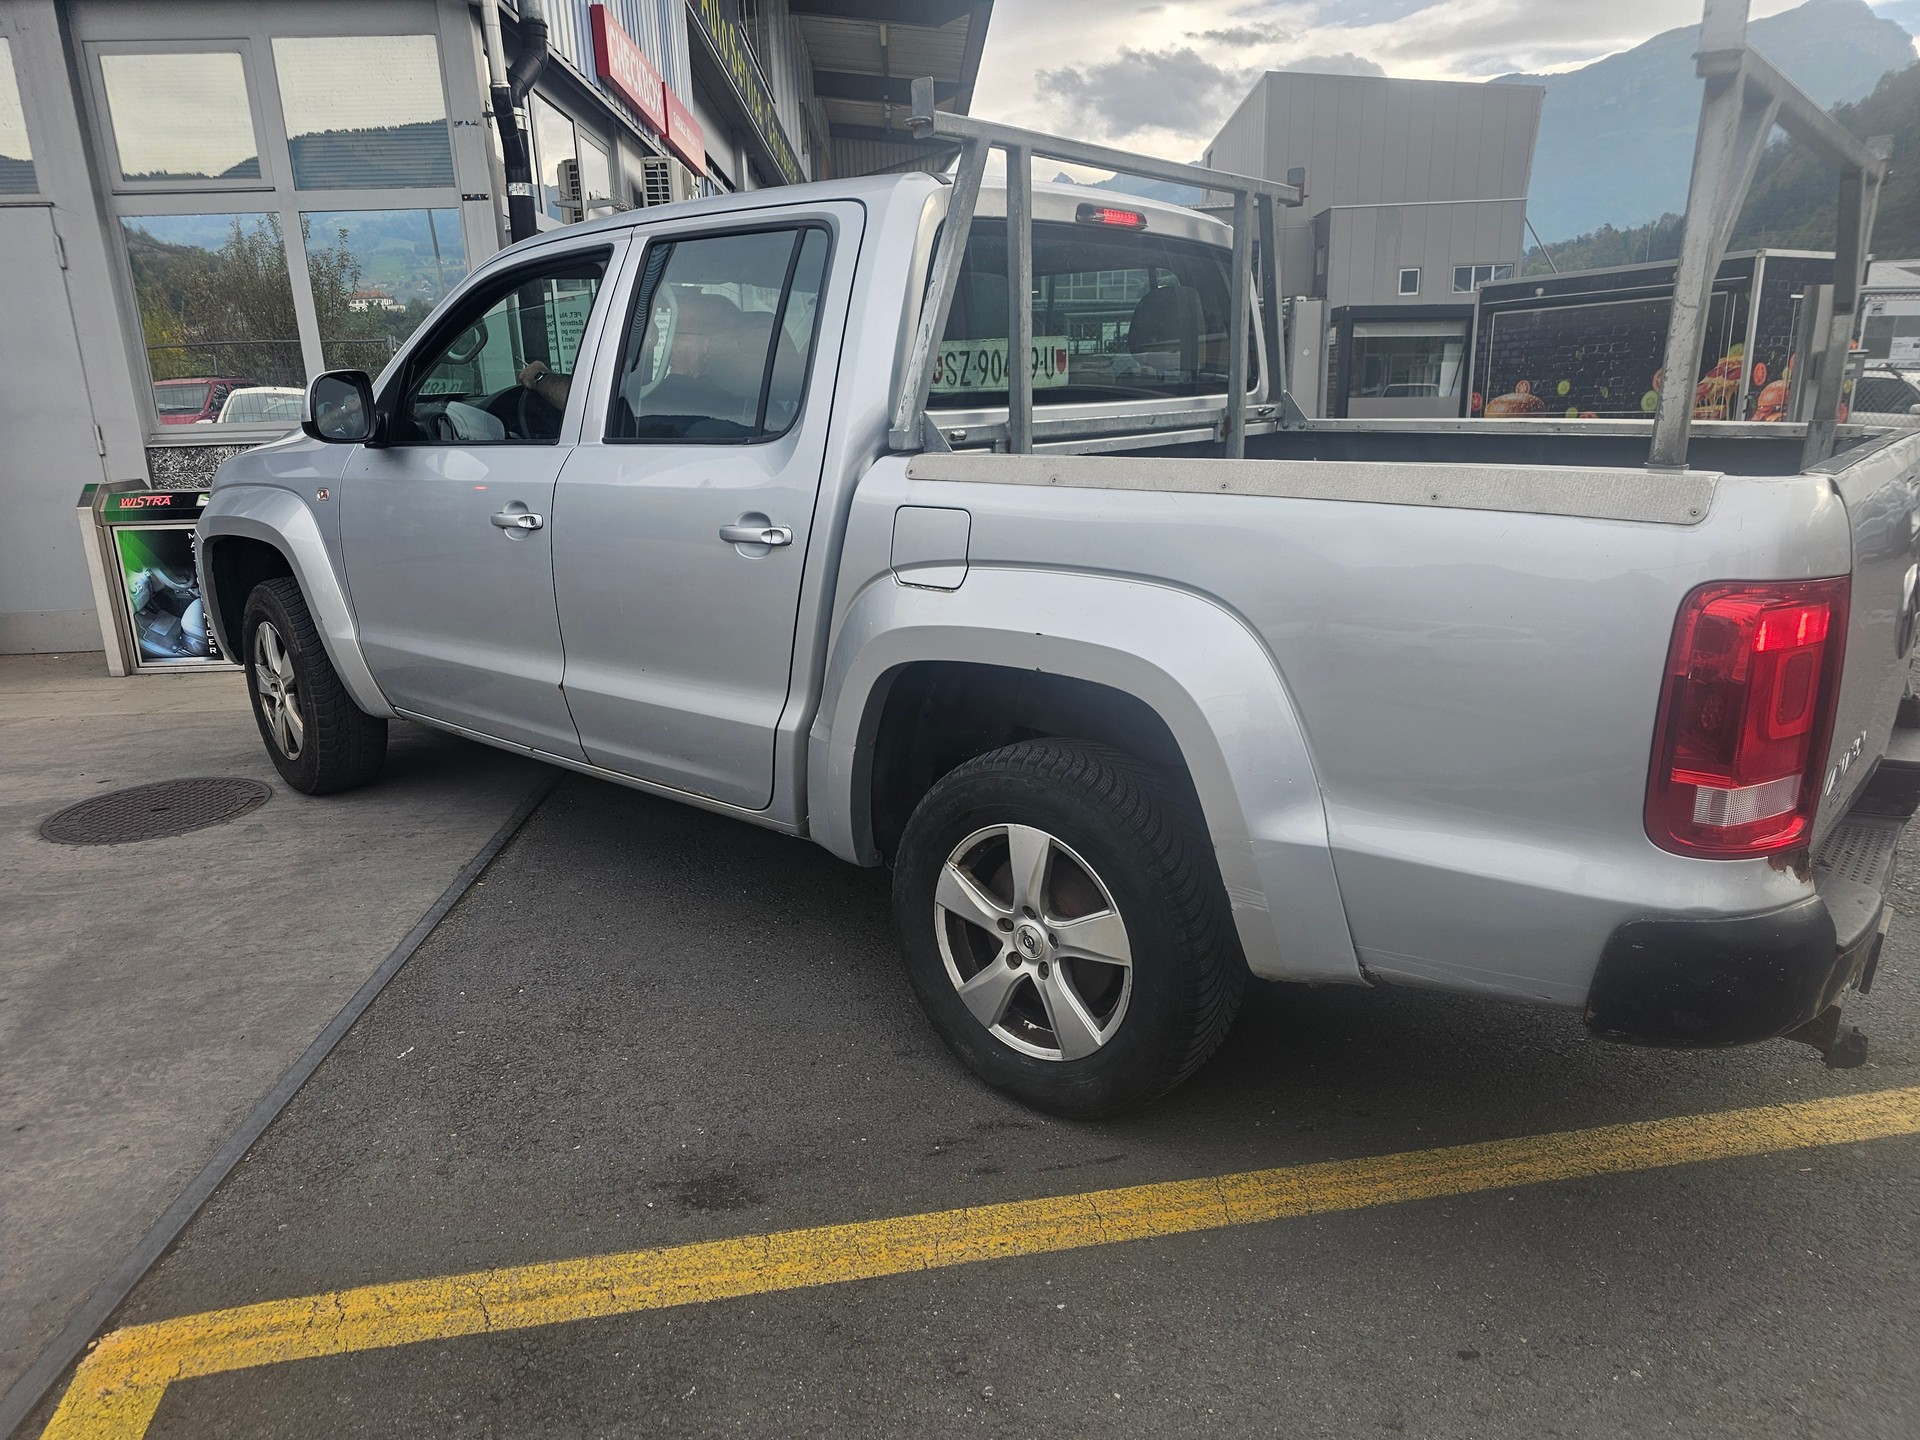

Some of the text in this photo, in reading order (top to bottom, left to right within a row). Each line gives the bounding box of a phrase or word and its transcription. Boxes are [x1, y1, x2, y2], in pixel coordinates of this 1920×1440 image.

[607, 24, 664, 122] CHECKBOX
[729, 22, 762, 125] Service
[119, 495, 173, 508] WISTRA
